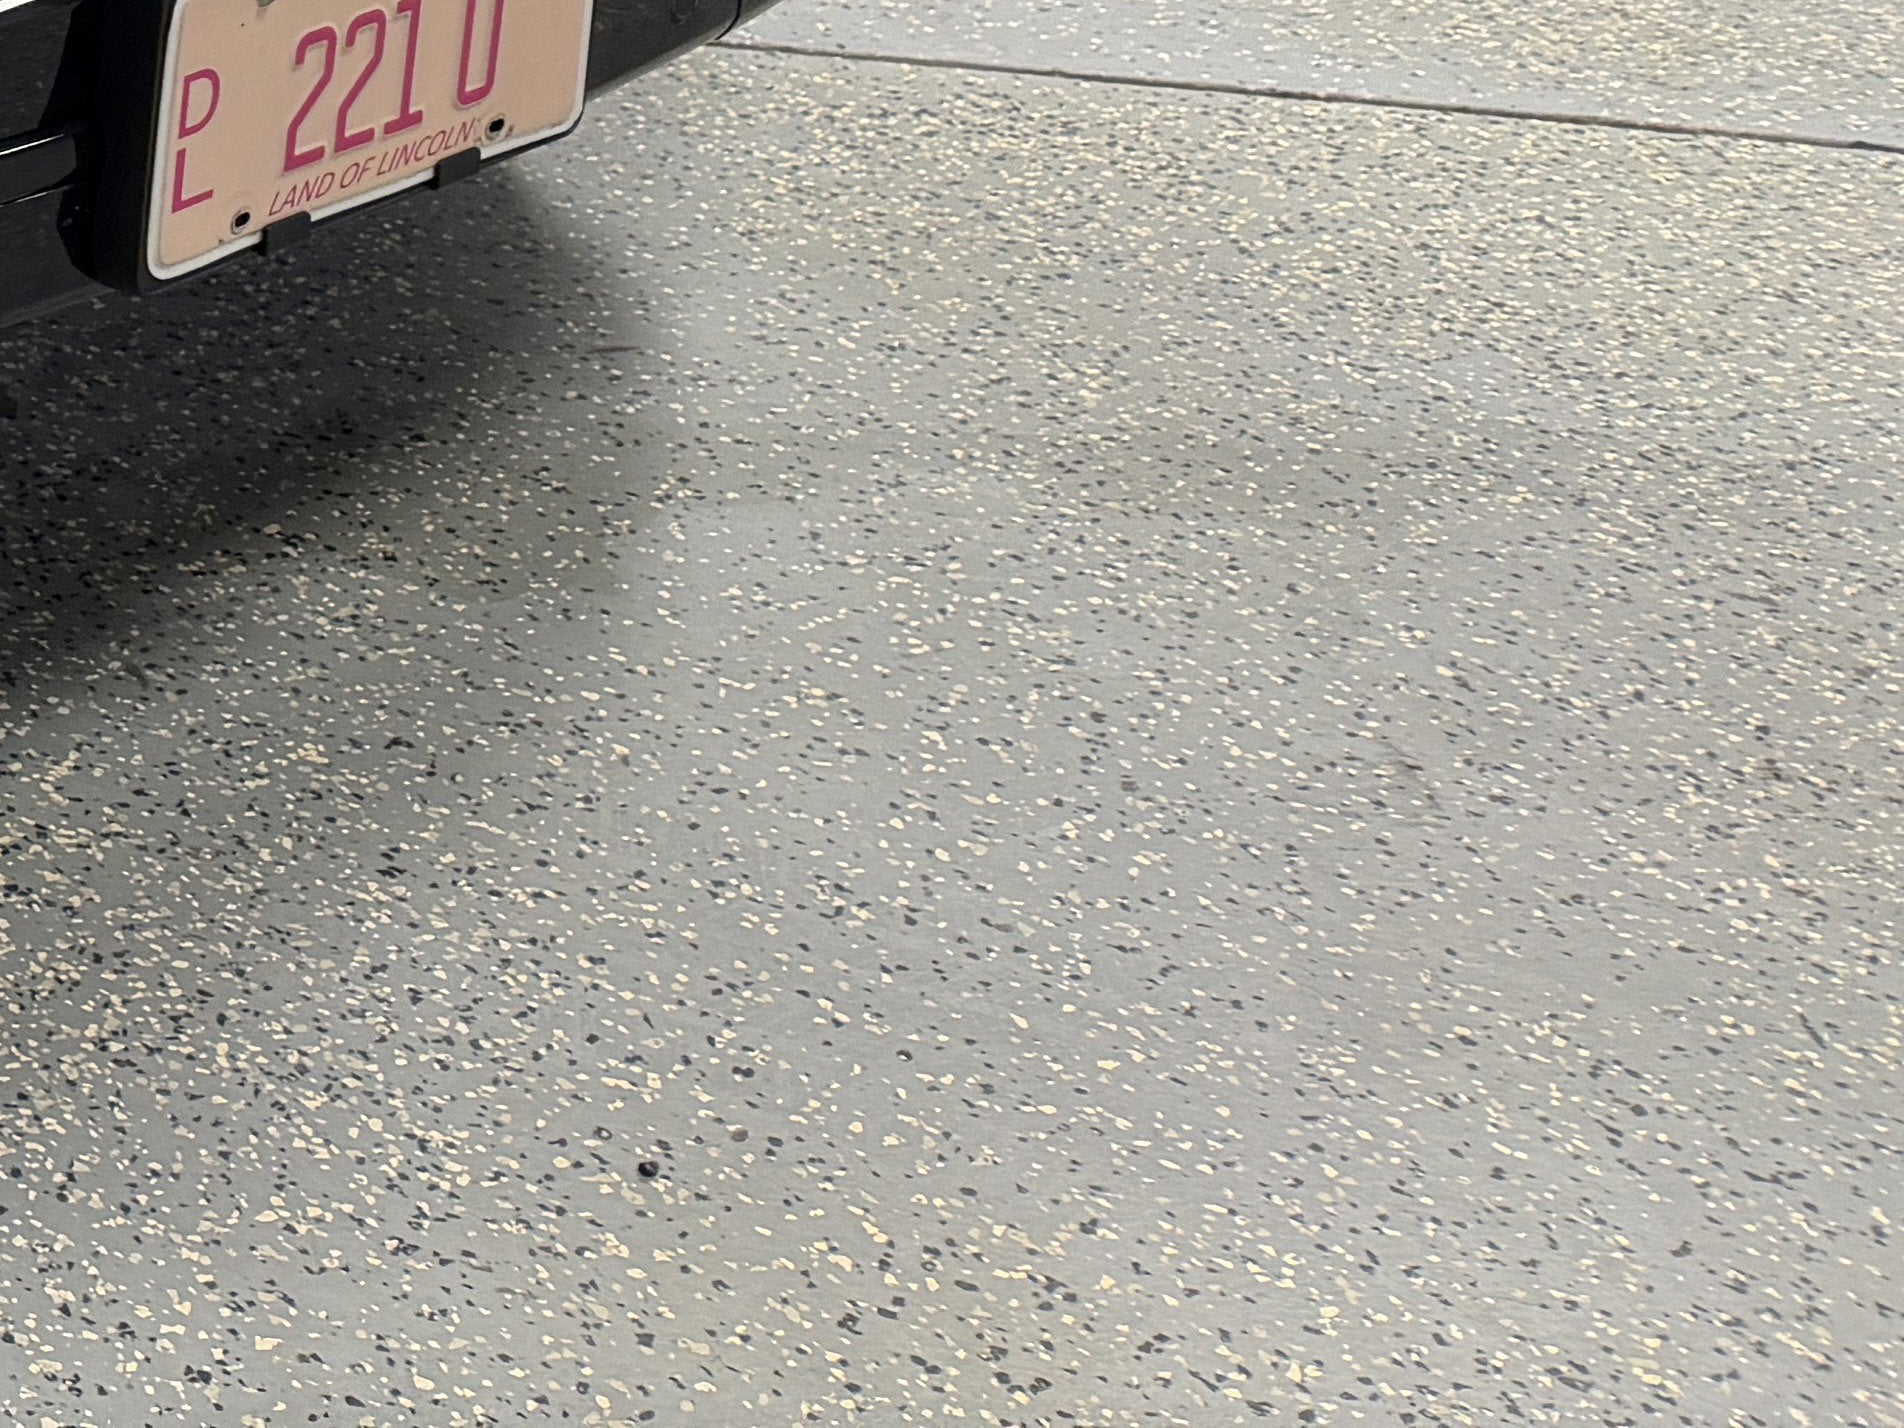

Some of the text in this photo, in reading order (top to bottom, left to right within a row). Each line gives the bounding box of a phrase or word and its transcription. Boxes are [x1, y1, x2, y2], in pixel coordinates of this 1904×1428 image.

[268, 117, 476, 217] LAND OF LINCOLN
